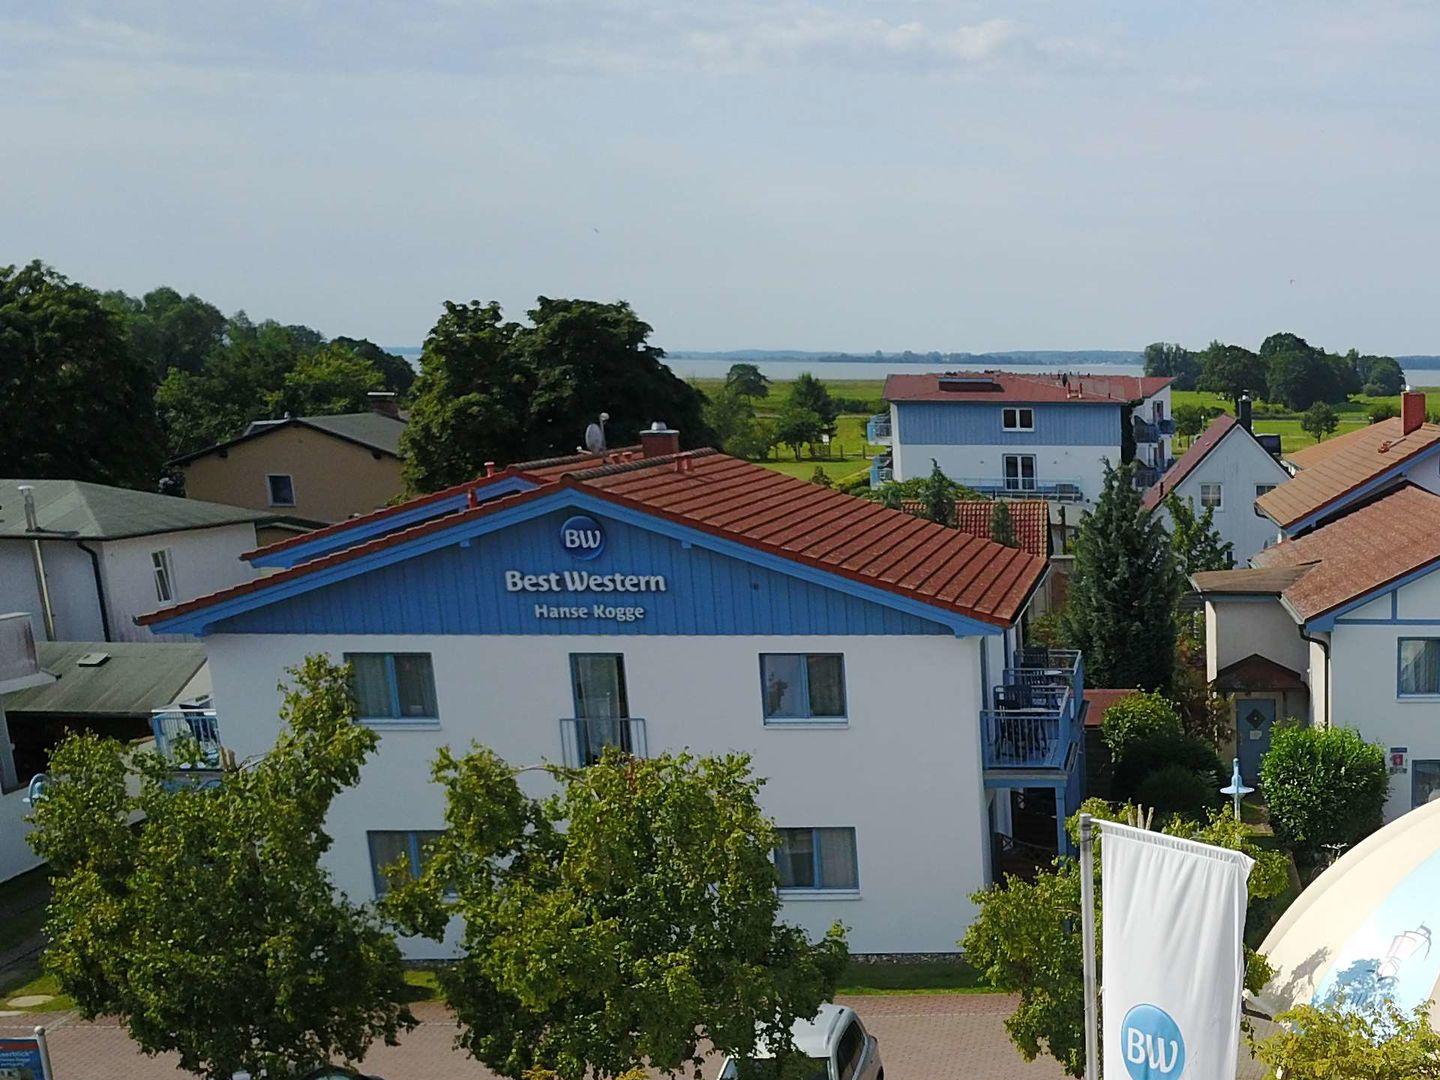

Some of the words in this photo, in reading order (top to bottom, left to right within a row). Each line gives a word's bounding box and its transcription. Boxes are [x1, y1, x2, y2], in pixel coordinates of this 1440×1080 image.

[565, 528, 600, 549] BW
[505, 570, 562, 592] Best
[564, 571, 666, 592] Western
[534, 604, 588, 618] Hanse
[594, 604, 645, 621] Kogge
[1127, 1027, 1178, 1073] BW
